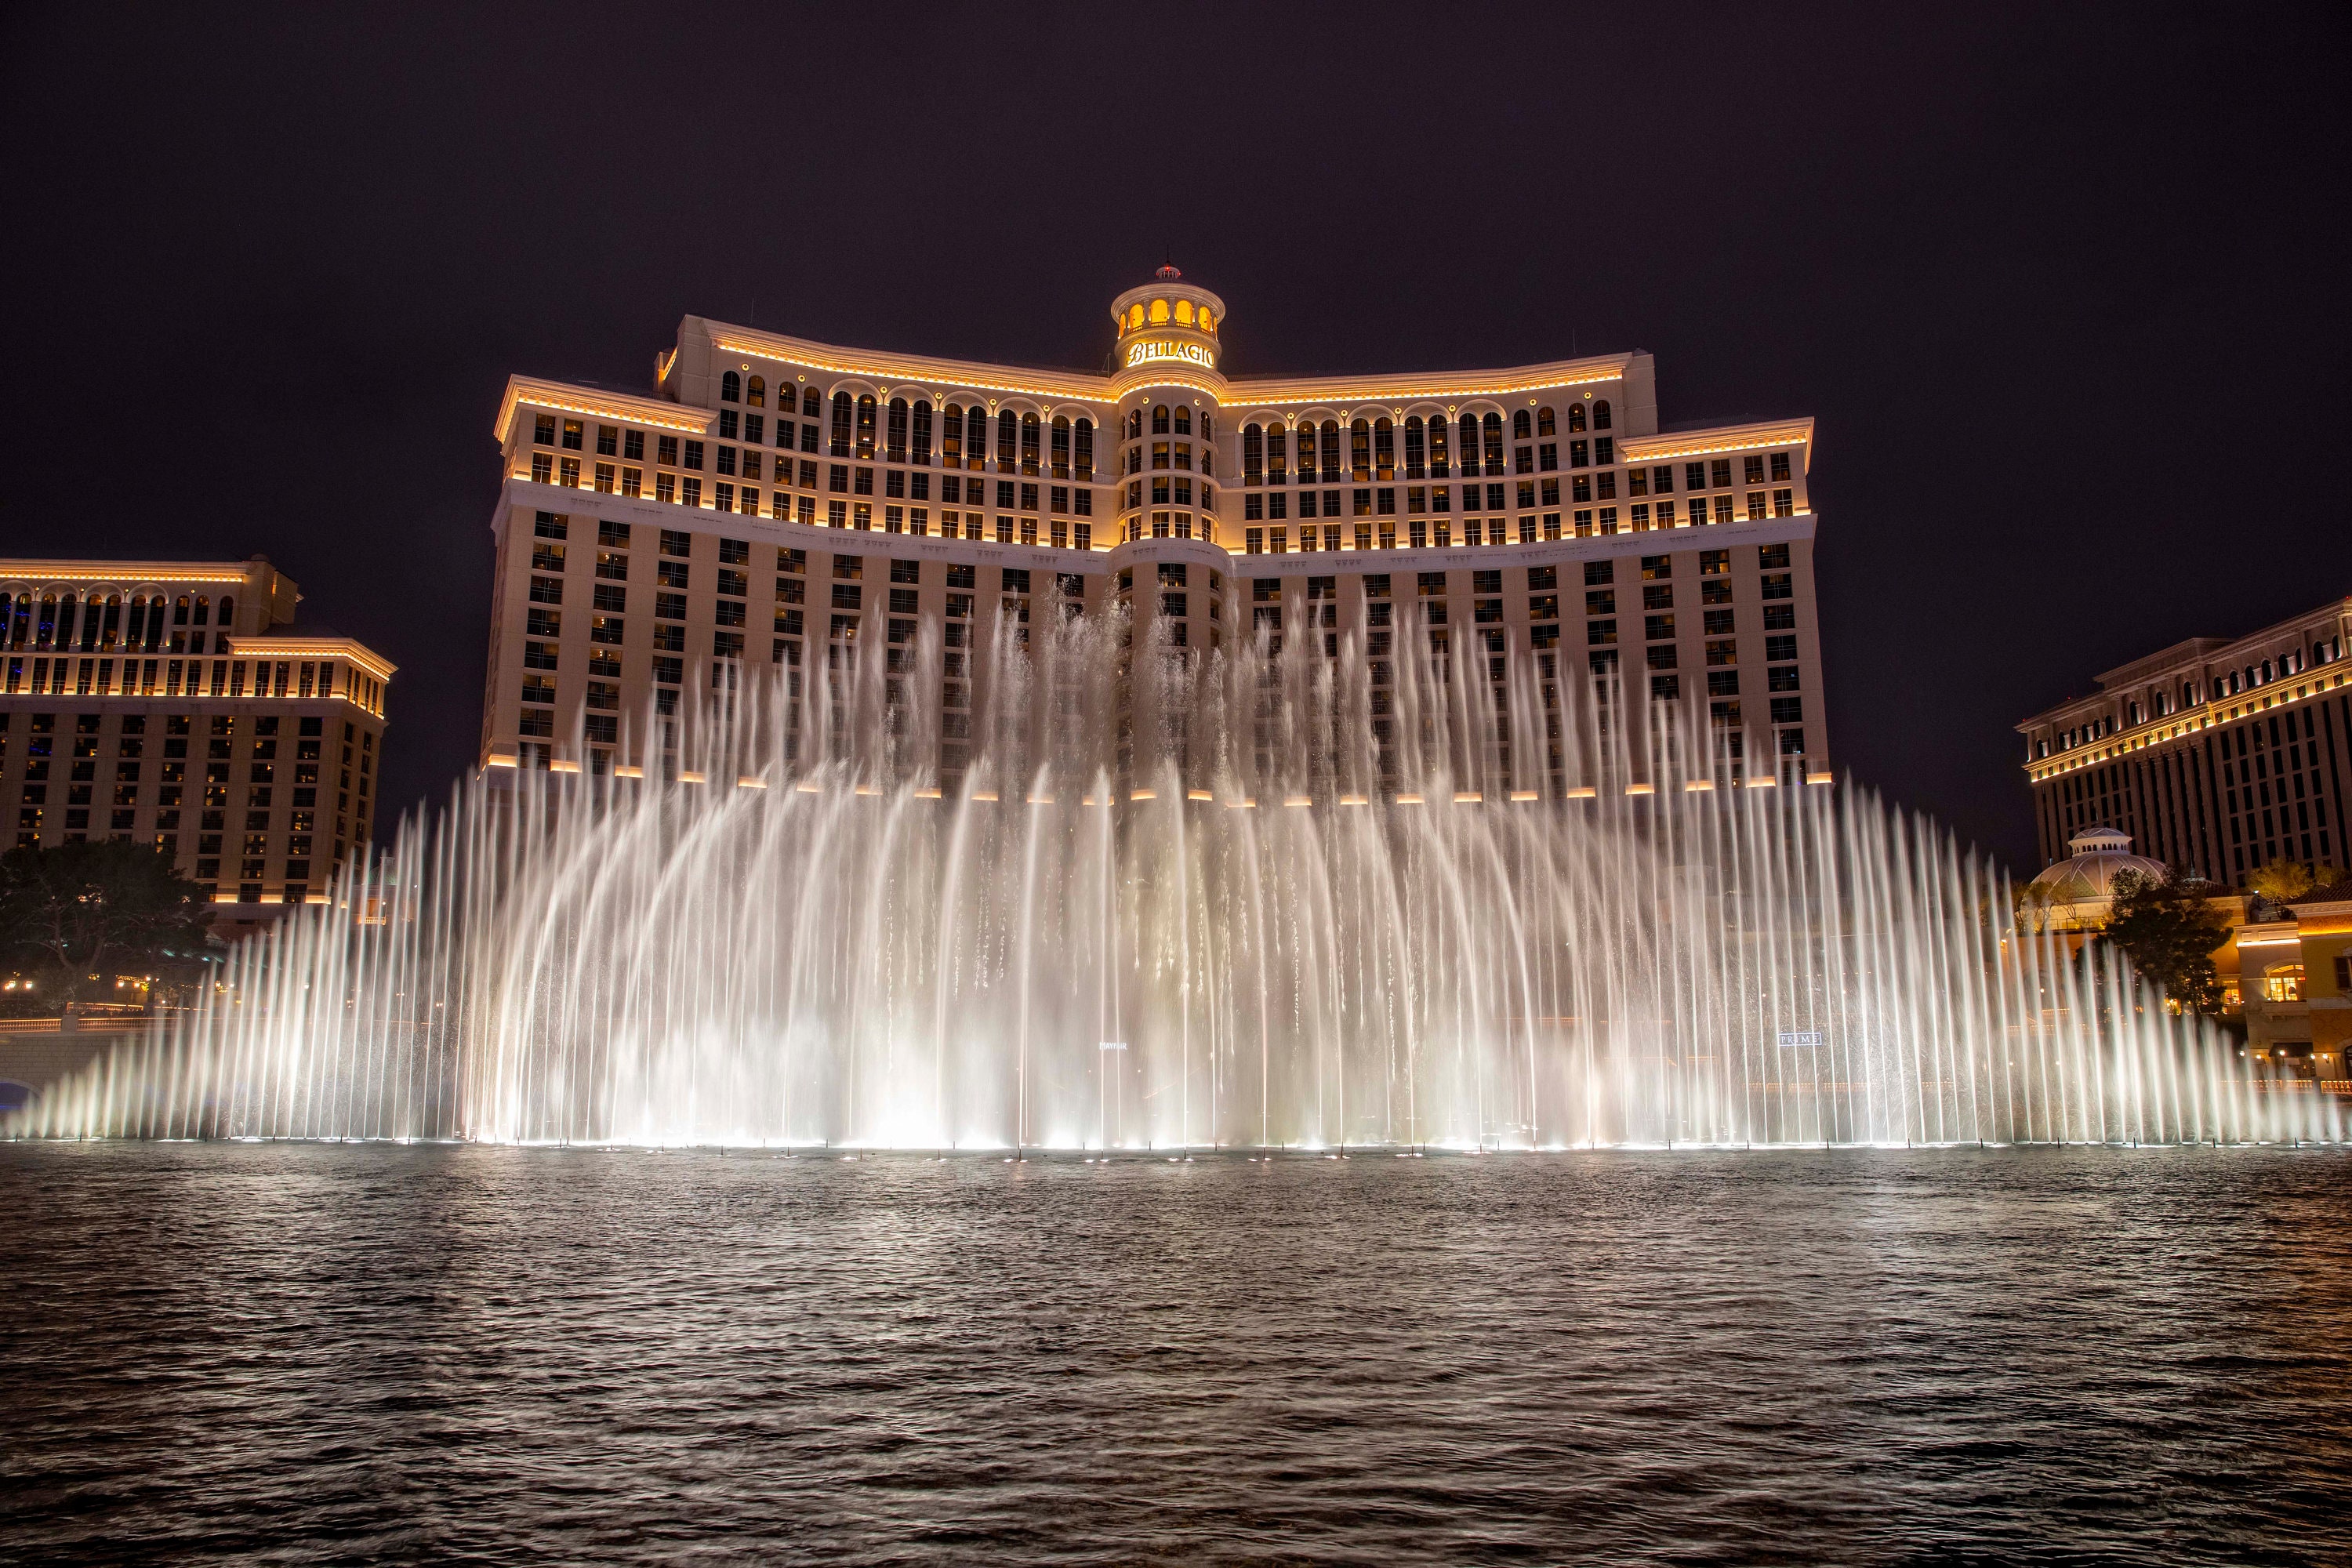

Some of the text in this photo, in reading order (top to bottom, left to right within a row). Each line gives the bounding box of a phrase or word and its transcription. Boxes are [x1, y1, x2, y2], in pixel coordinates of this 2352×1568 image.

[1126, 341, 1215, 366] BELLAGIO
[1780, 1035, 1819, 1044] PRIME
[1099, 1041, 1127, 1051] MAYFAIR
